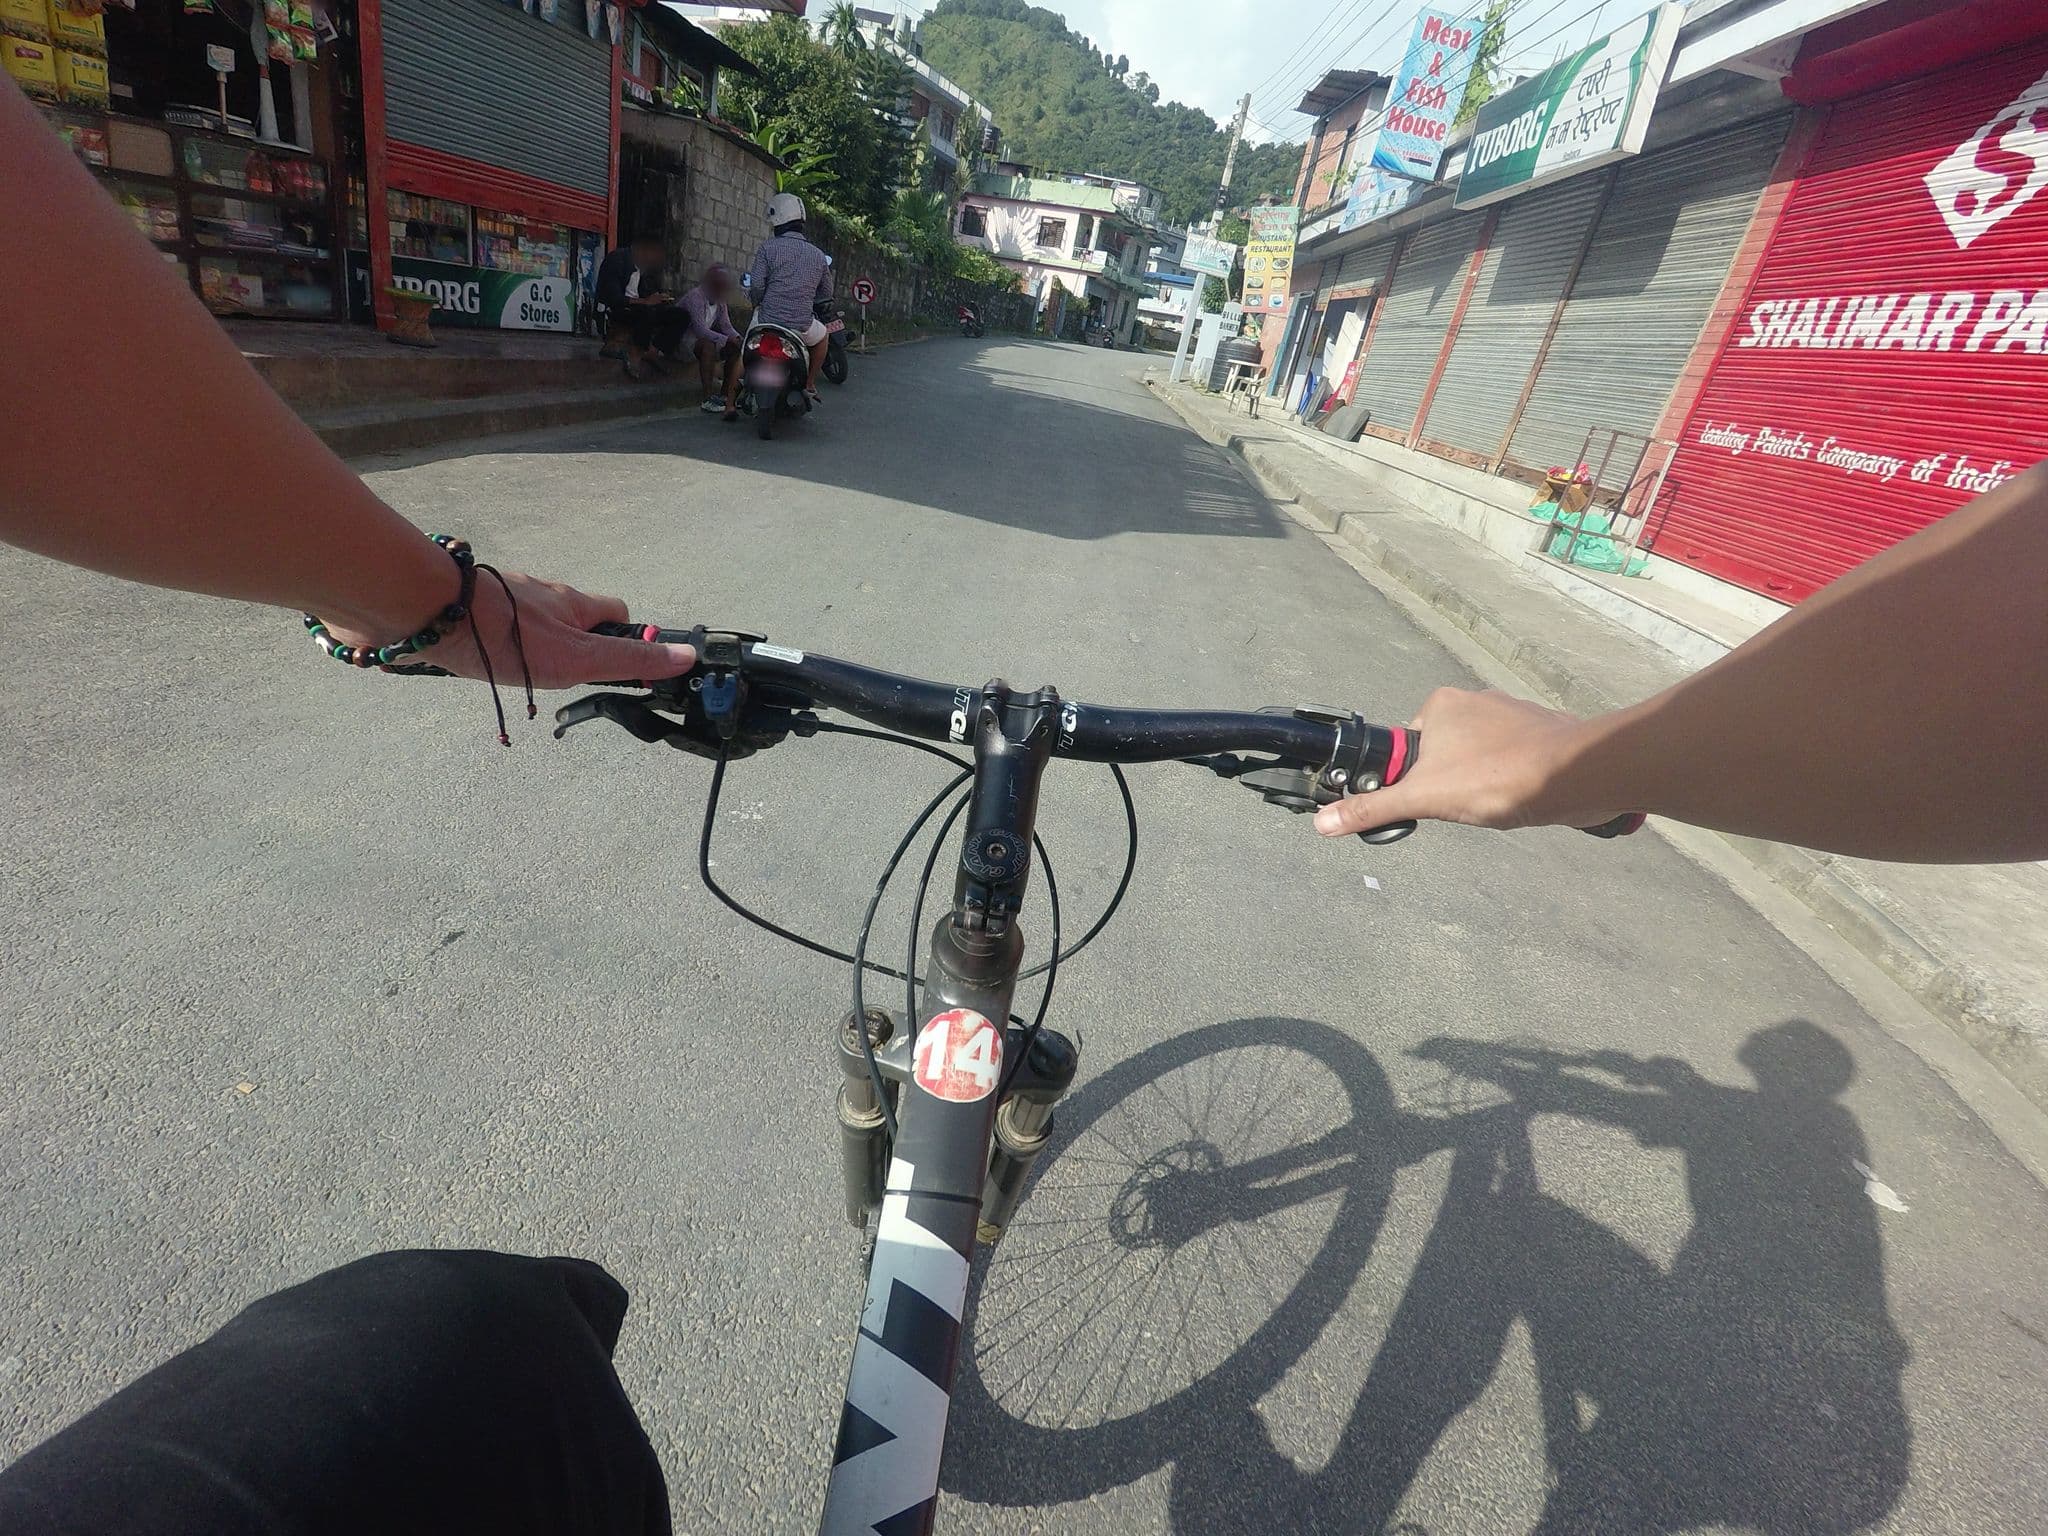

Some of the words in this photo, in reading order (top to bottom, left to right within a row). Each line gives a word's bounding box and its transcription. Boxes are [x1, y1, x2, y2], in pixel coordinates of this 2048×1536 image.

[1421, 15, 1473, 51] Meat
[1428, 51, 1443, 77] &
[1405, 77, 1447, 110] Fish
[1385, 105, 1447, 142] House
[1467, 99, 1550, 175] TUBORG
[1250, 245, 1293, 253] RESTAURANT
[530, 283, 552, 303] G.C
[520, 302, 560, 324] Stores
[1738, 291, 1976, 352] SHALIMAR
[1961, 288, 2048, 355] PA
[1751, 427, 1814, 460] Paints
[1816, 436, 1907, 482] Company
[1910, 454, 1948, 483] of
[1944, 455, 2015, 493] Indi
[914, 1020, 996, 1089] 14
